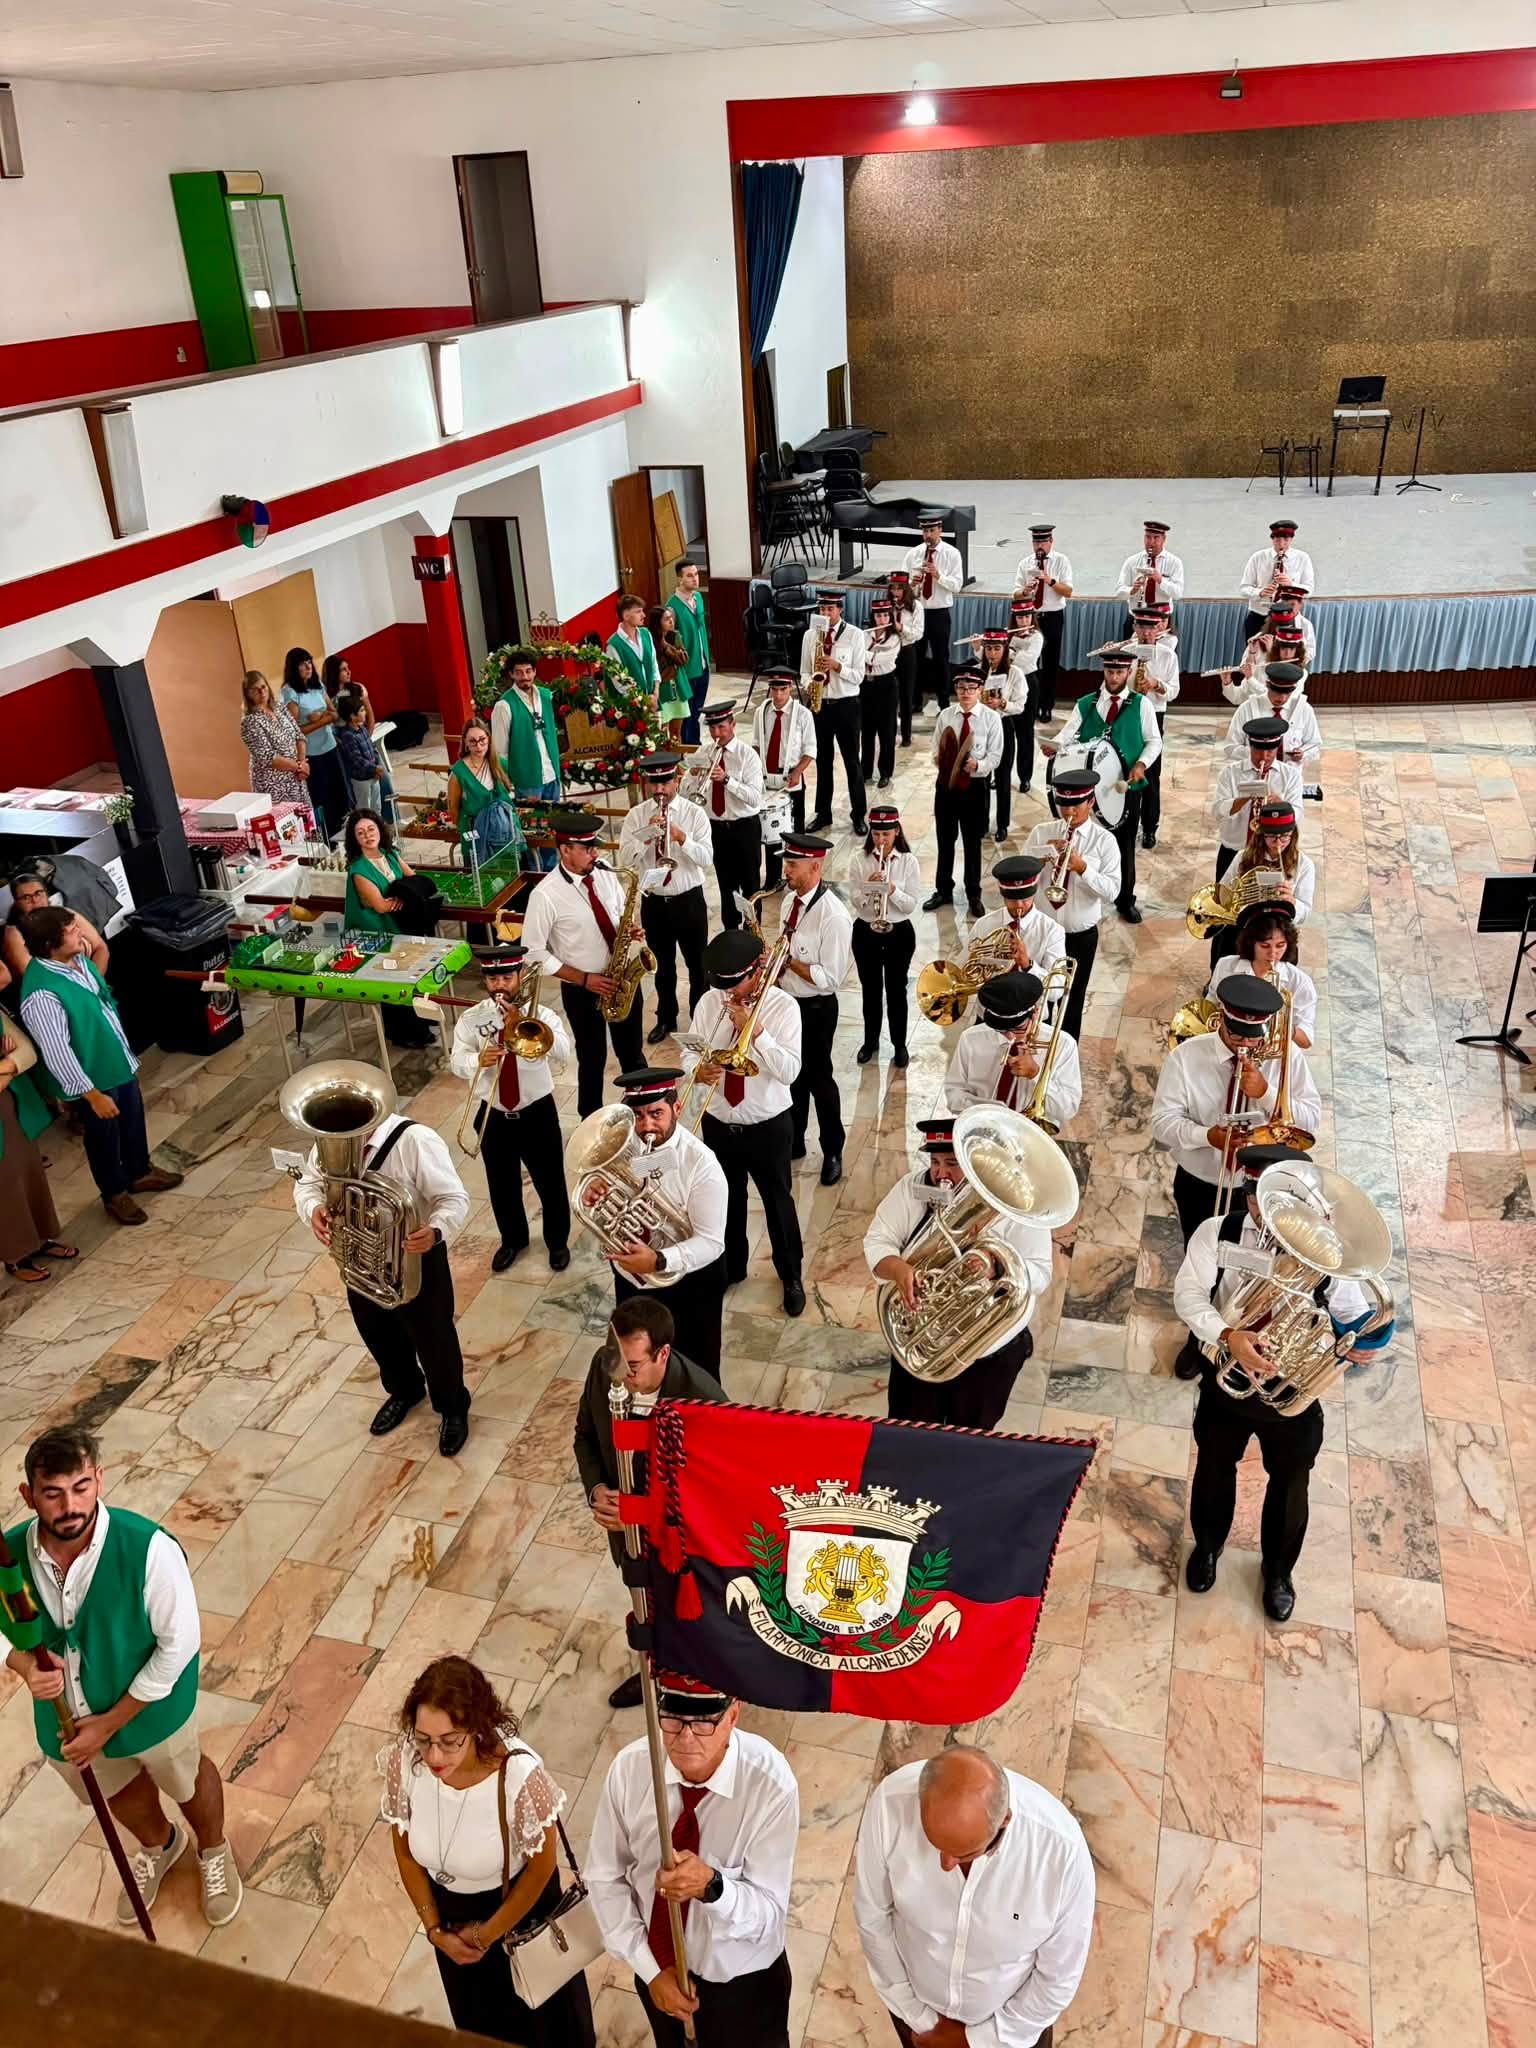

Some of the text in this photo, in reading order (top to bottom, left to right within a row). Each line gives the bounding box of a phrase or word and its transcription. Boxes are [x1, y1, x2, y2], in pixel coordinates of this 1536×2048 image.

[418, 562, 440, 575] WC
[794, 1604, 840, 1633] FUNDADA
[847, 1625, 866, 1634] EM
[751, 1610, 931, 1671] FILARMONICA ALCANEDENSE
